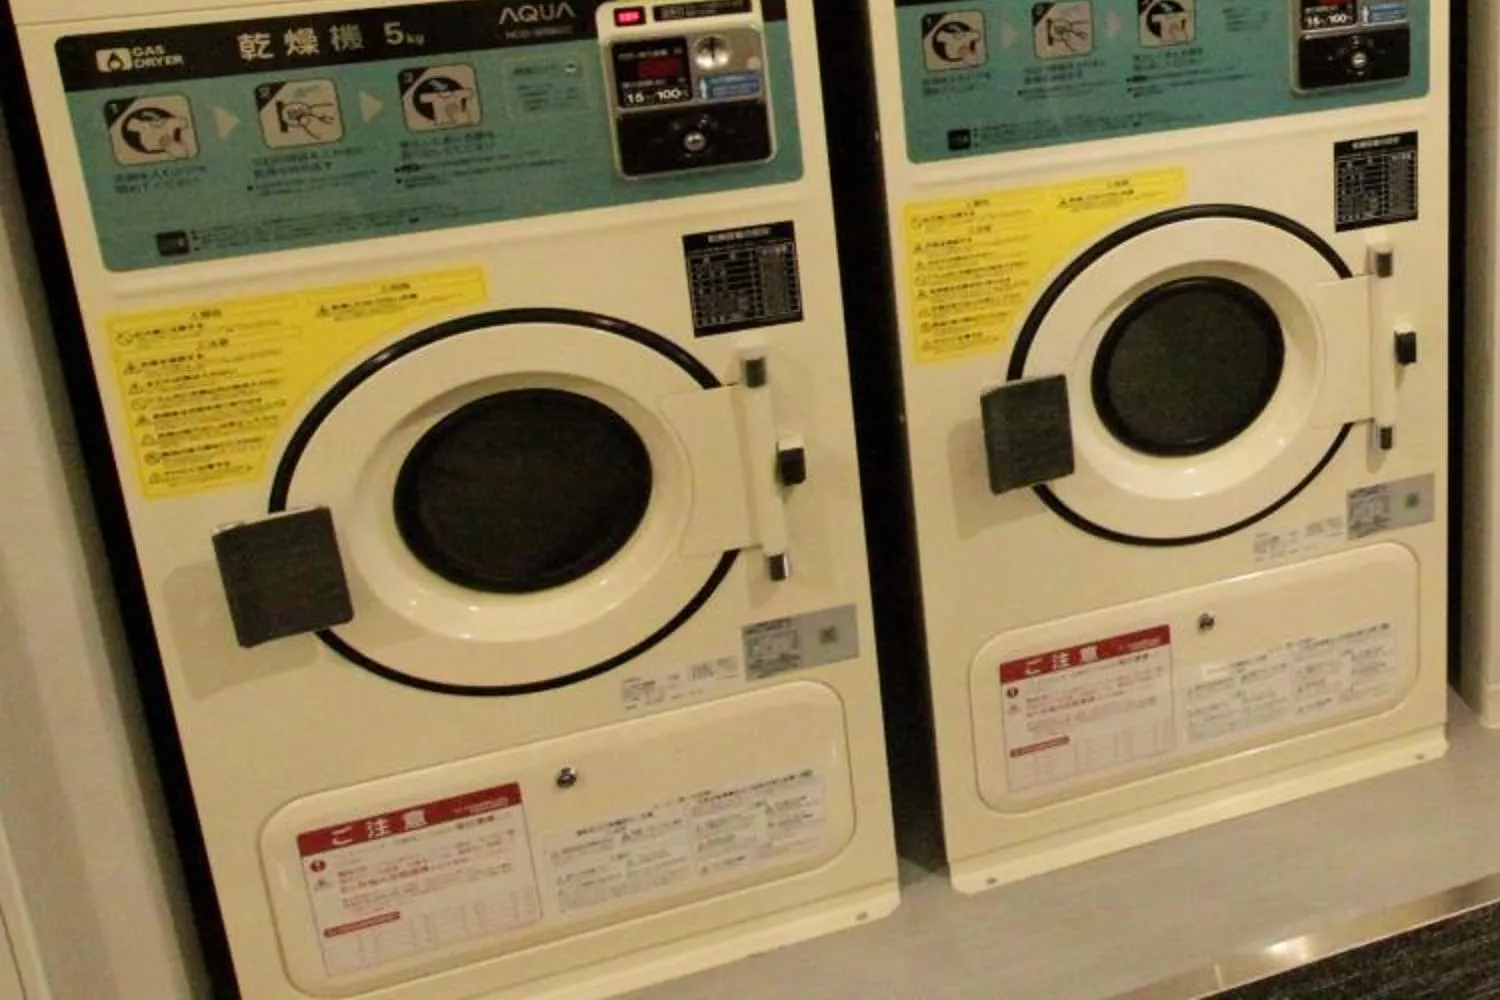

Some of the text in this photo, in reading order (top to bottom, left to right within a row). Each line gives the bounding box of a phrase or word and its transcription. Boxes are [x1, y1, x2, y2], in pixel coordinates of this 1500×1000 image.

[499, 1, 577, 26] AQUA
[132, 44, 166, 58] GAS
[237, 23, 365, 62] 乾燥機
[133, 53, 184, 70] DRYER
